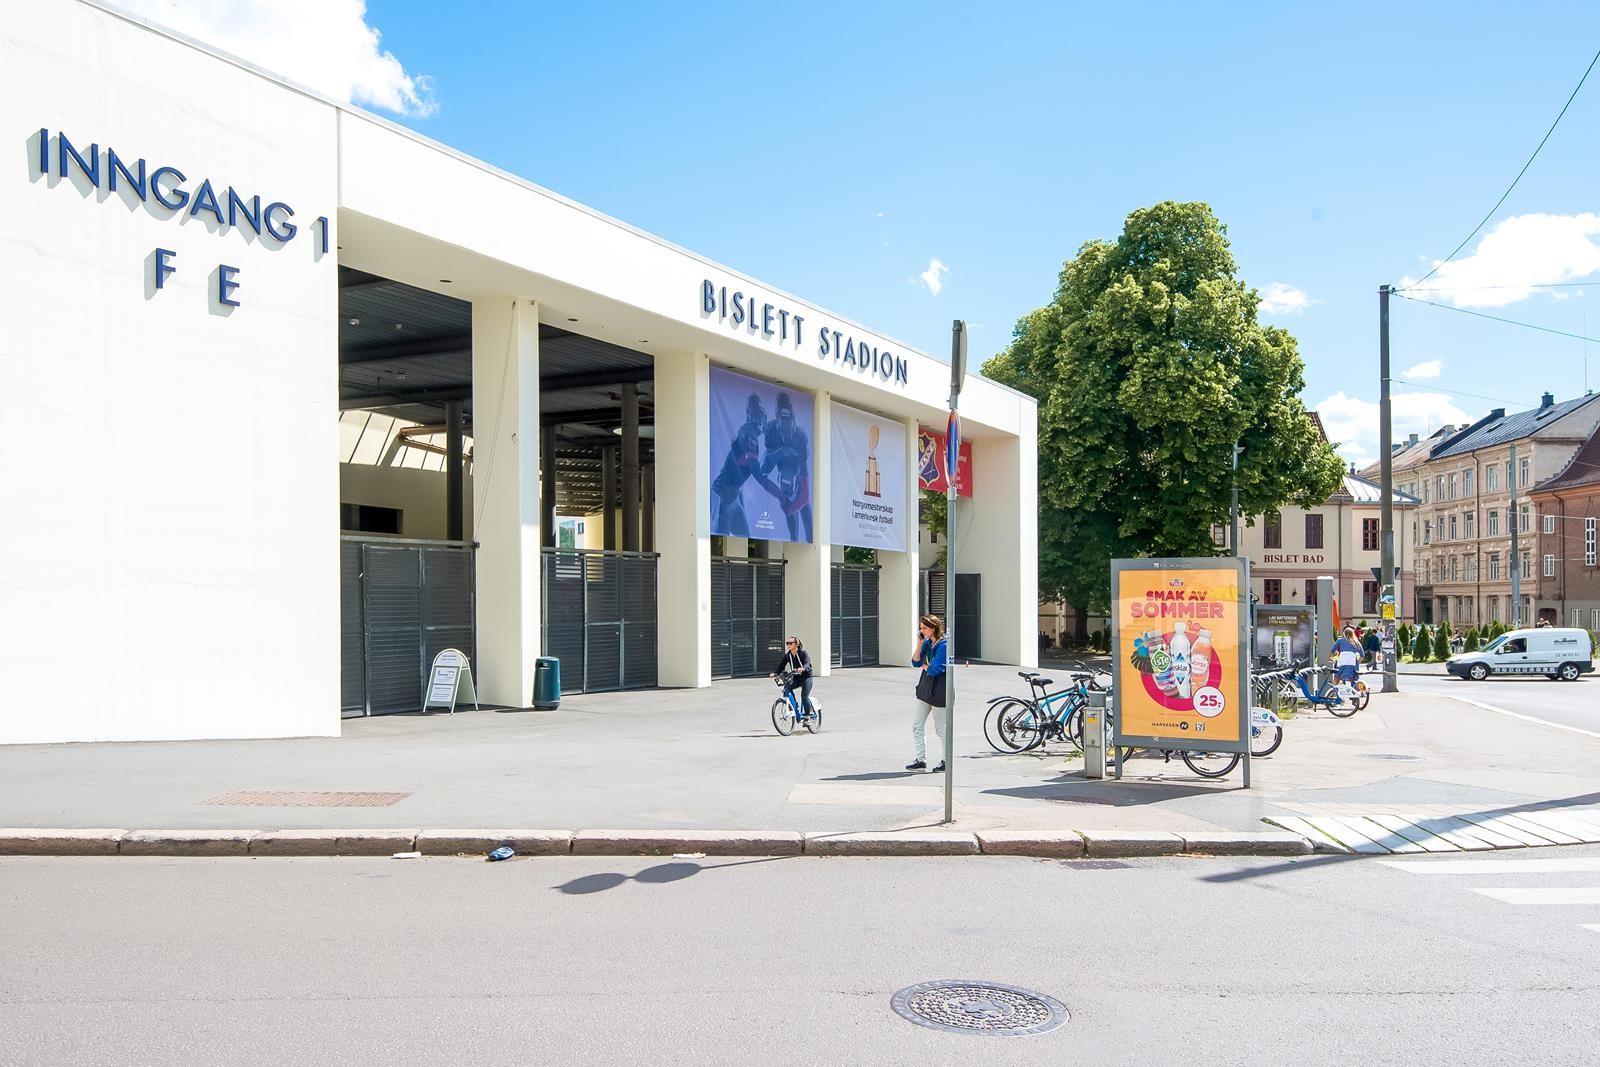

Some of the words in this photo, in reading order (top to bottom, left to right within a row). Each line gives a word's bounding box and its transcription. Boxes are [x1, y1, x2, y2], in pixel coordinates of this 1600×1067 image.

[40, 127, 297, 242] INNGANG
[318, 216, 329, 254] 1
[155, 247, 177, 289] F
[219, 264, 241, 307] E
[703, 279, 805, 345] BISLETT
[820, 326, 908, 385] STADION
[1263, 554, 1299, 563] BISLET
[1302, 554, 1324, 563] BAD
[1130, 602, 1224, 619] SOMMER
[1146, 590, 1184, 601] SMAK
[1188, 590, 1208, 602] AV
